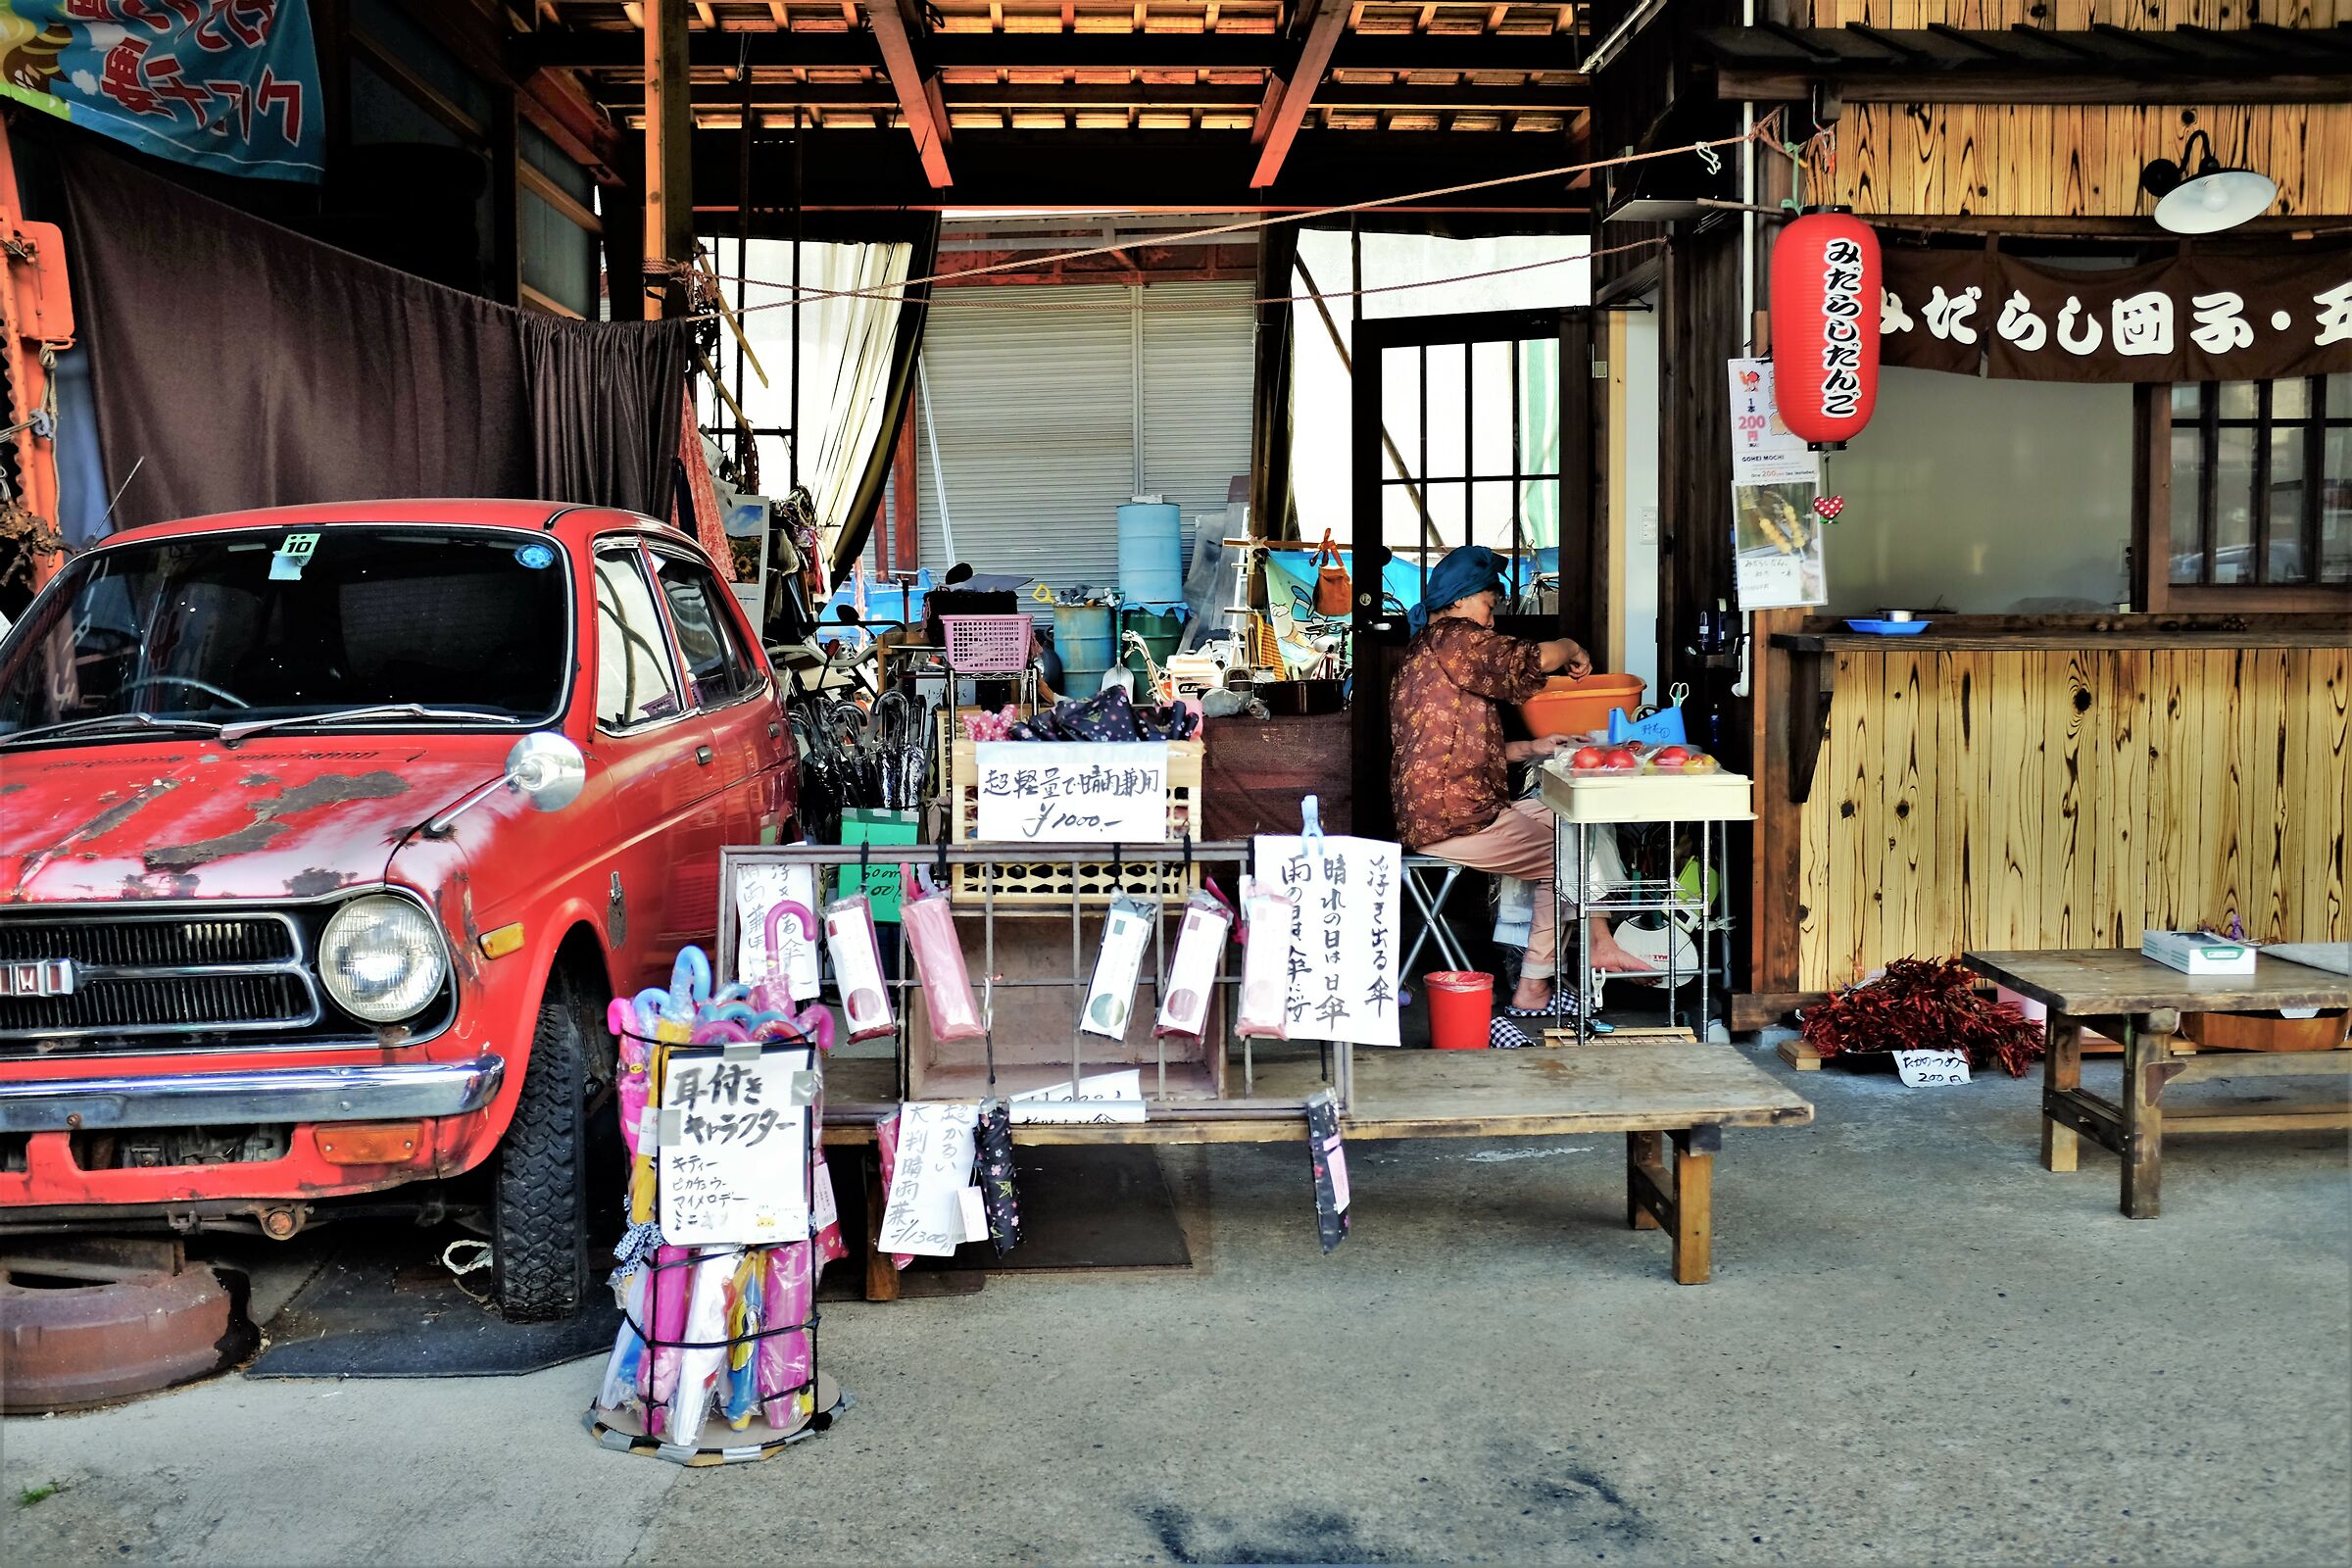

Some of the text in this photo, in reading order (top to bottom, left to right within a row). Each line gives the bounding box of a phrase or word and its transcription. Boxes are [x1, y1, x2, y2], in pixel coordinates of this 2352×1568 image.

[1739, 415, 1766, 430] 200
[287, 541, 313, 554] 10
[1918, 1072, 1964, 1084] 200円
[669, 1062, 763, 1111] 耳付き
